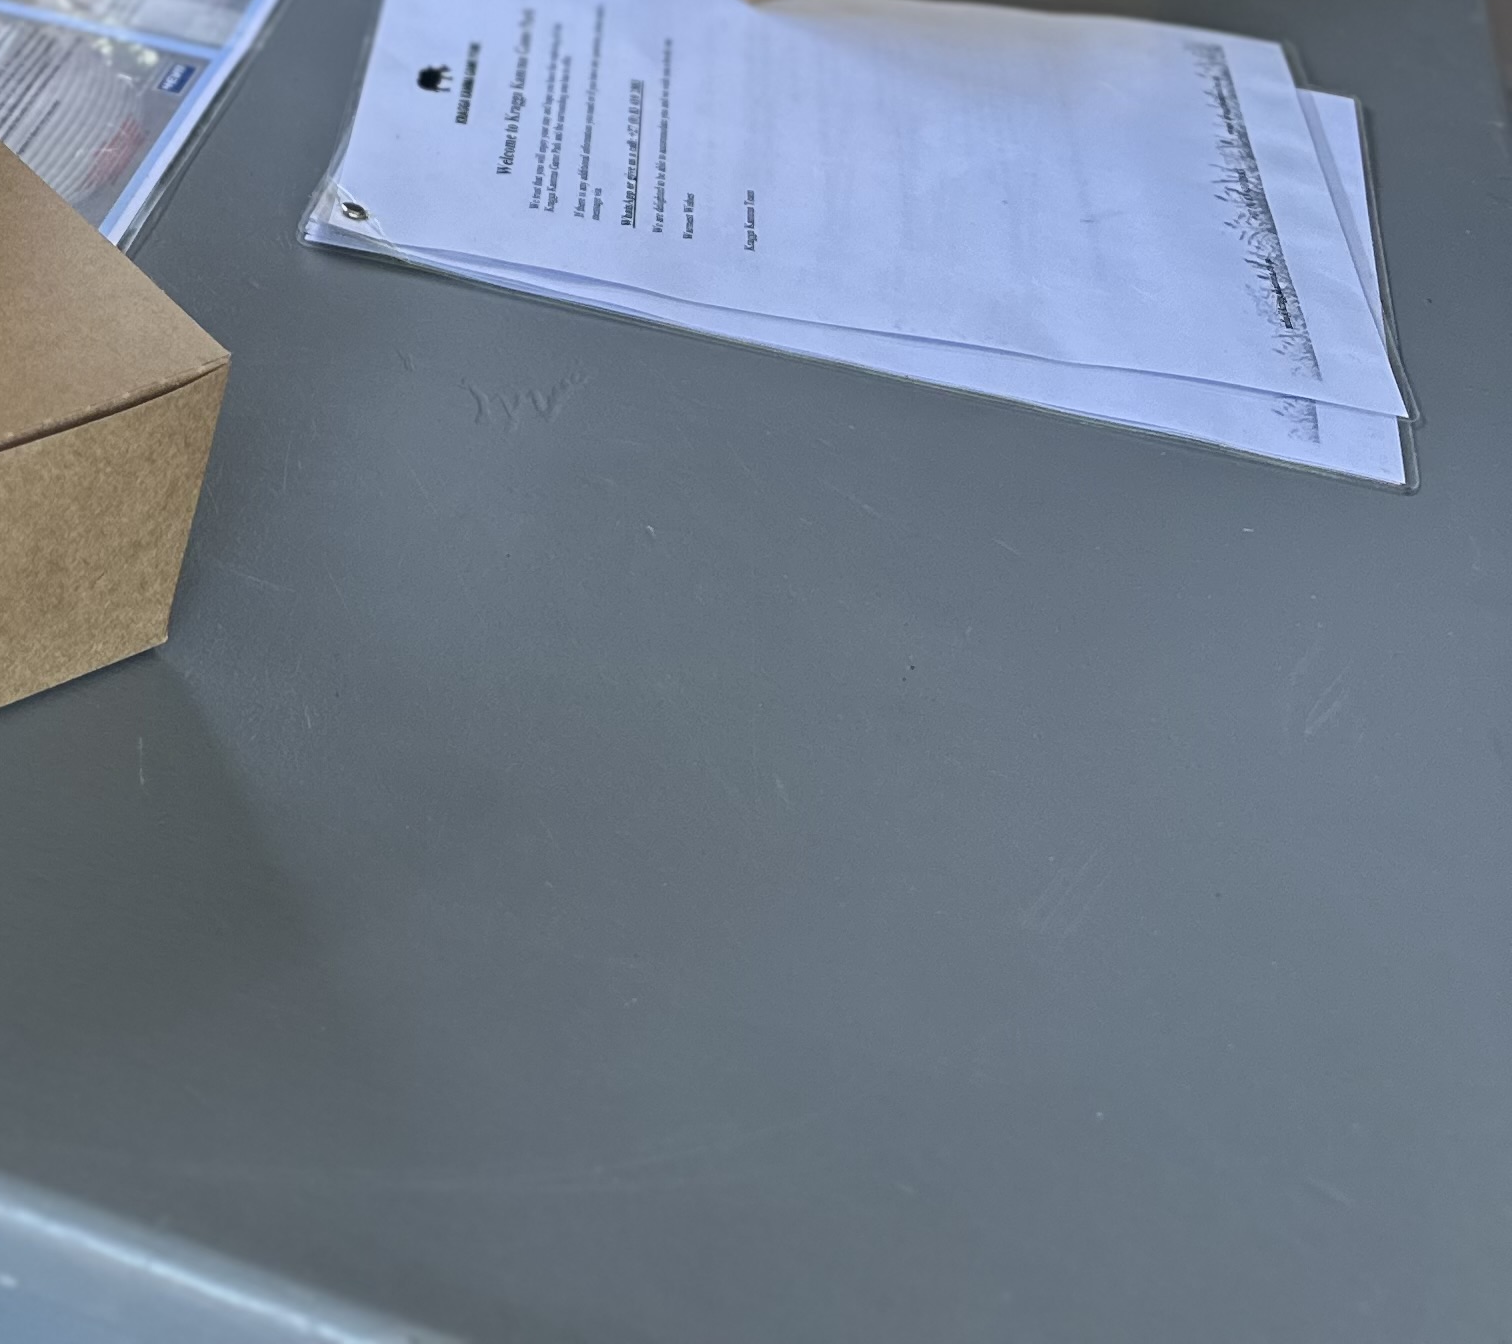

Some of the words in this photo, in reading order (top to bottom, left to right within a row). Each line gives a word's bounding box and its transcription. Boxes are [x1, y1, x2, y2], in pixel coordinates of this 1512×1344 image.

[505, 90, 527, 123] Kragga
[504, 122, 517, 132] to
[497, 133, 516, 175] Welcome
